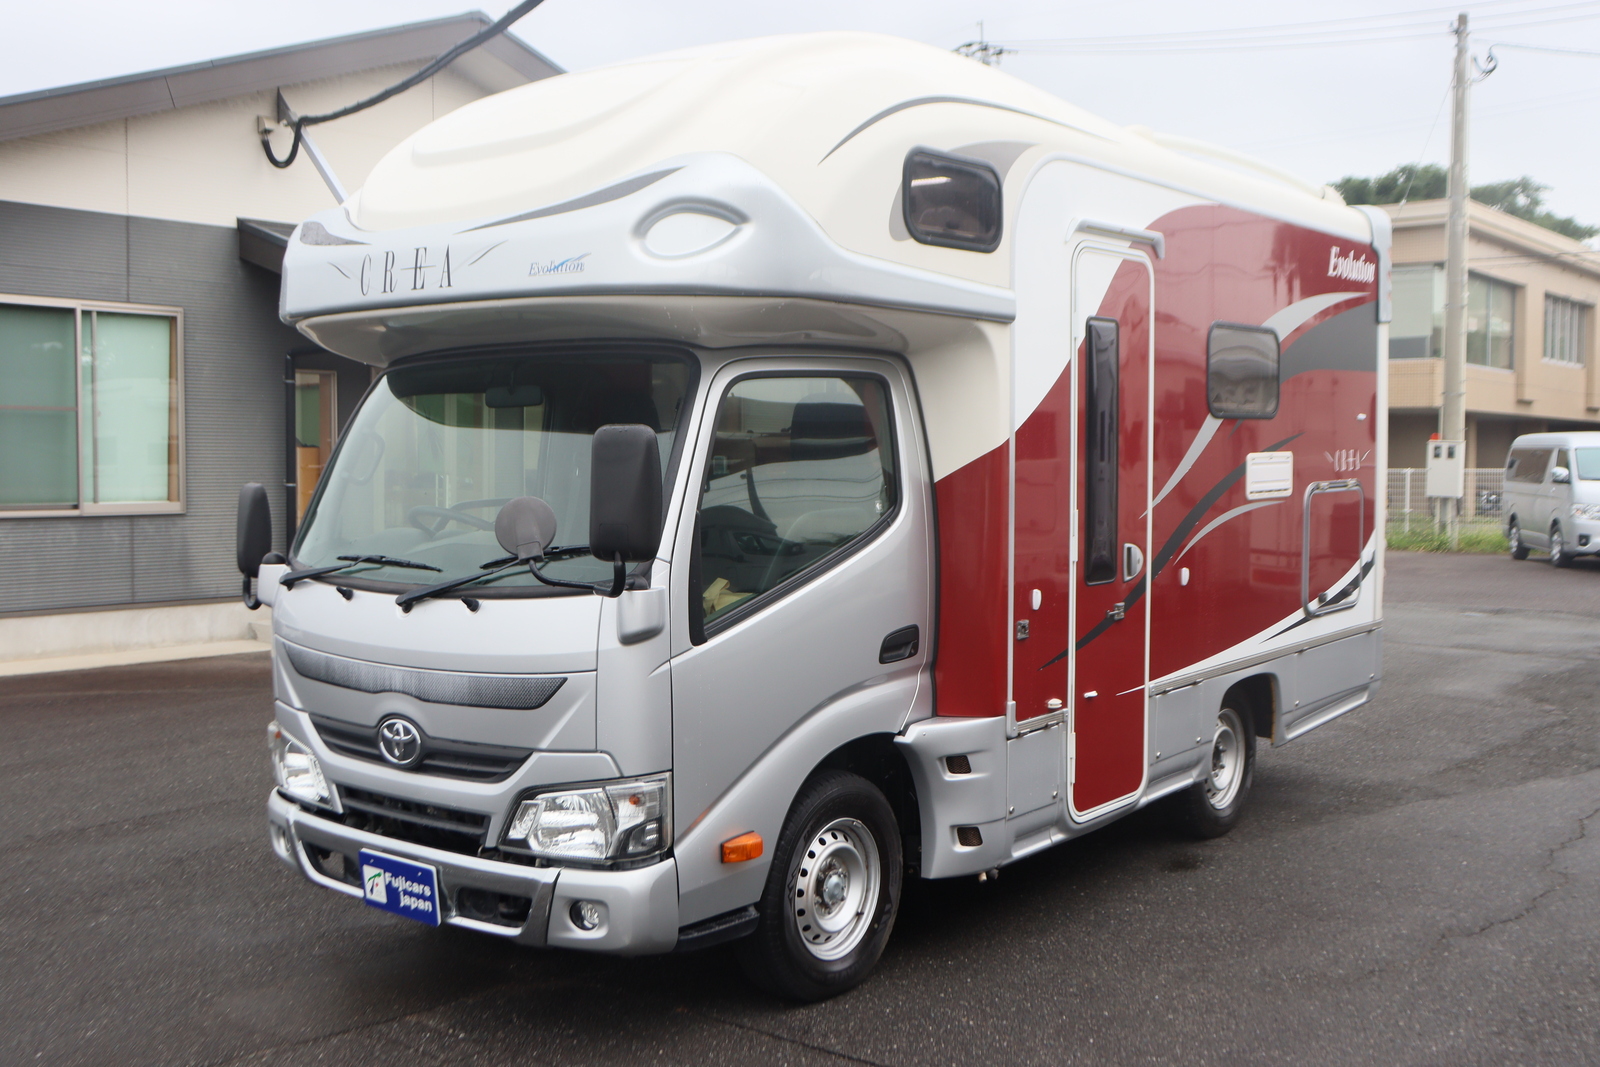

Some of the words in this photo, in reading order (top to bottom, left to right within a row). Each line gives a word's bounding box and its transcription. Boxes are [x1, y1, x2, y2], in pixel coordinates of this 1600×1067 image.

[360, 244, 453, 296] CREA
[528, 259, 585, 277] Evolution
[1327, 245, 1376, 284] Evolution
[384, 871, 432, 897] Fujicars
